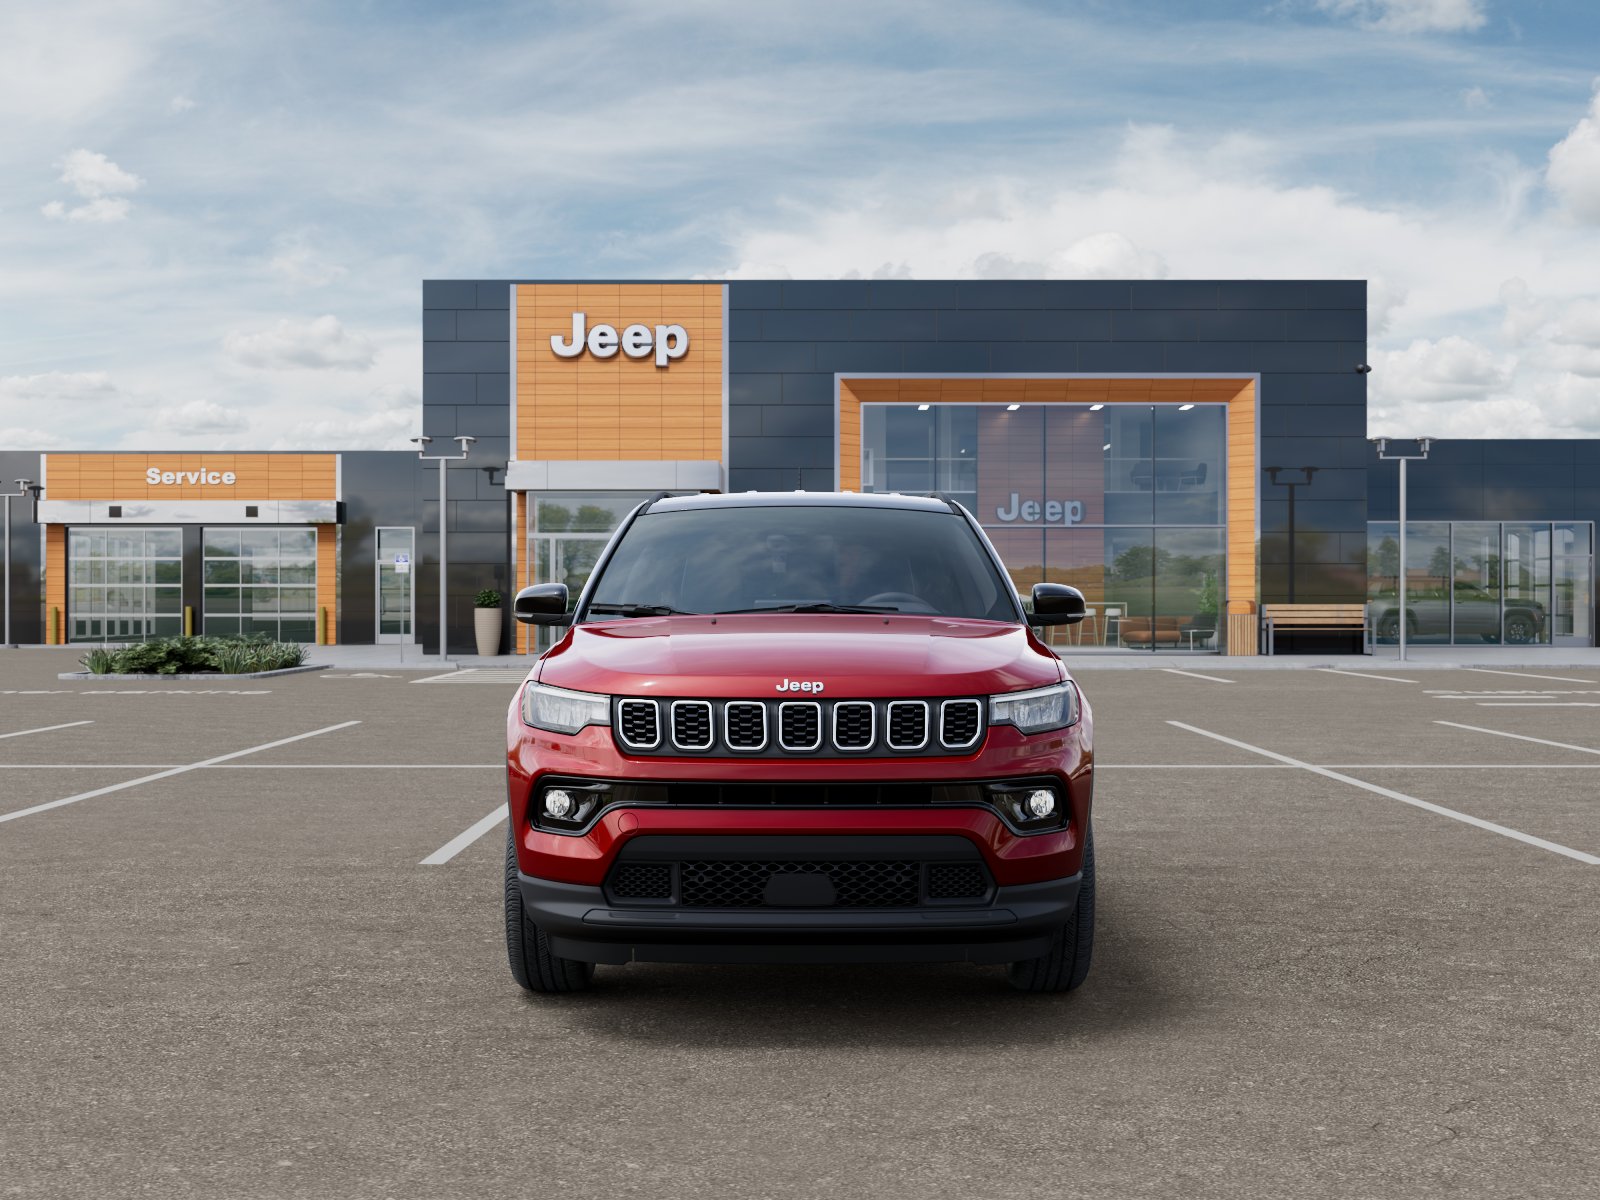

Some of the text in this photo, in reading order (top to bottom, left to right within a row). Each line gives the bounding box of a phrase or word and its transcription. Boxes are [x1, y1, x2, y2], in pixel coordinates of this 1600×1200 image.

[550, 312, 689, 367] Jeep
[145, 467, 237, 486] Service
[996, 493, 1083, 526] Jeep
[776, 678, 824, 694] Jeep
